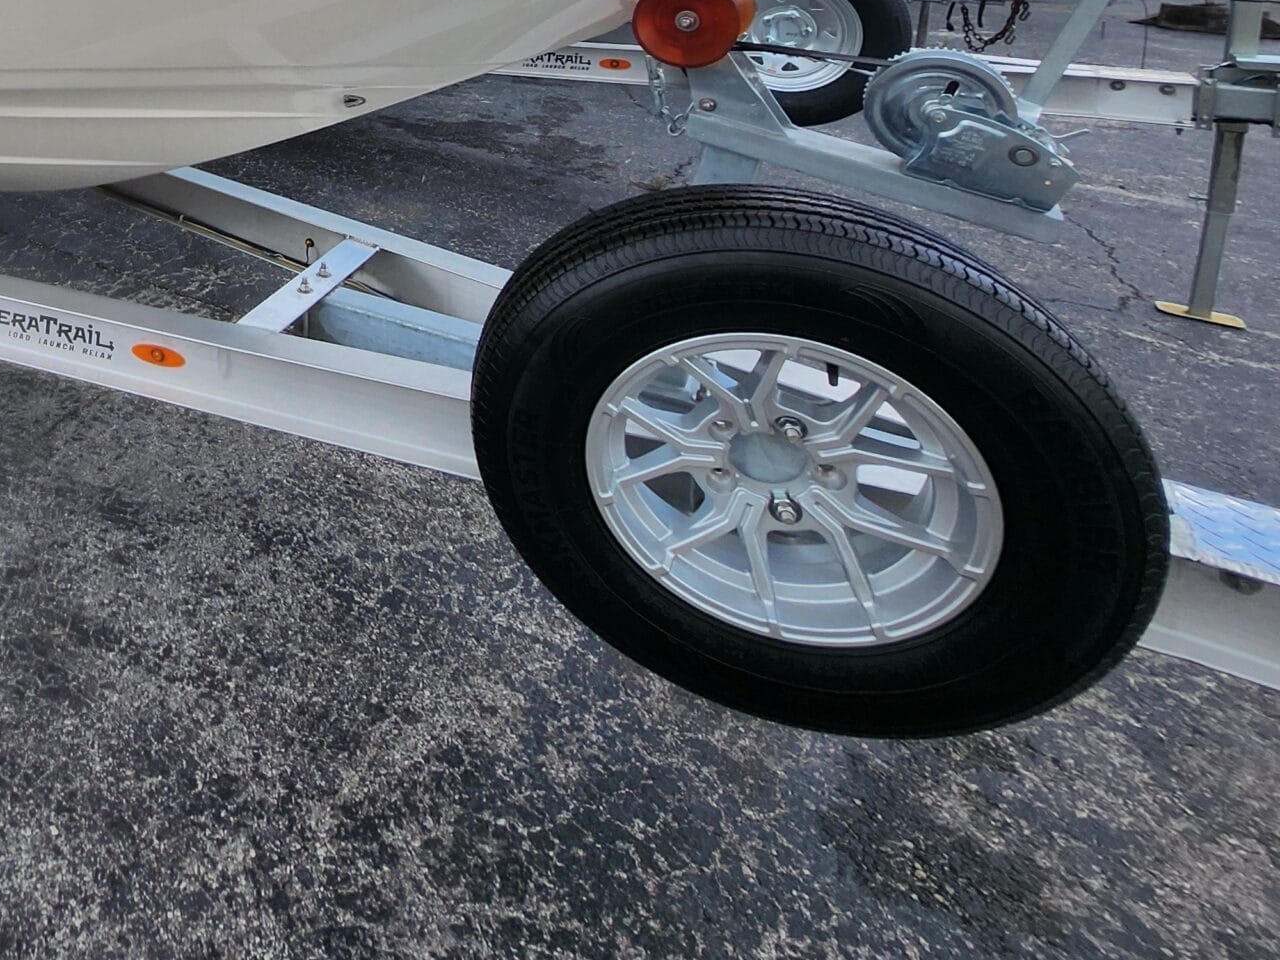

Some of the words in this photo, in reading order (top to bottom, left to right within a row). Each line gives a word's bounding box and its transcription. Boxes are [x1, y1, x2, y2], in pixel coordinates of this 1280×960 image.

[529, 52, 591, 65] ATRAIL
[8, 331, 31, 341] LOAD
[38, 339, 75, 352] LAUNCH
[82, 348, 112, 361] RELAX
